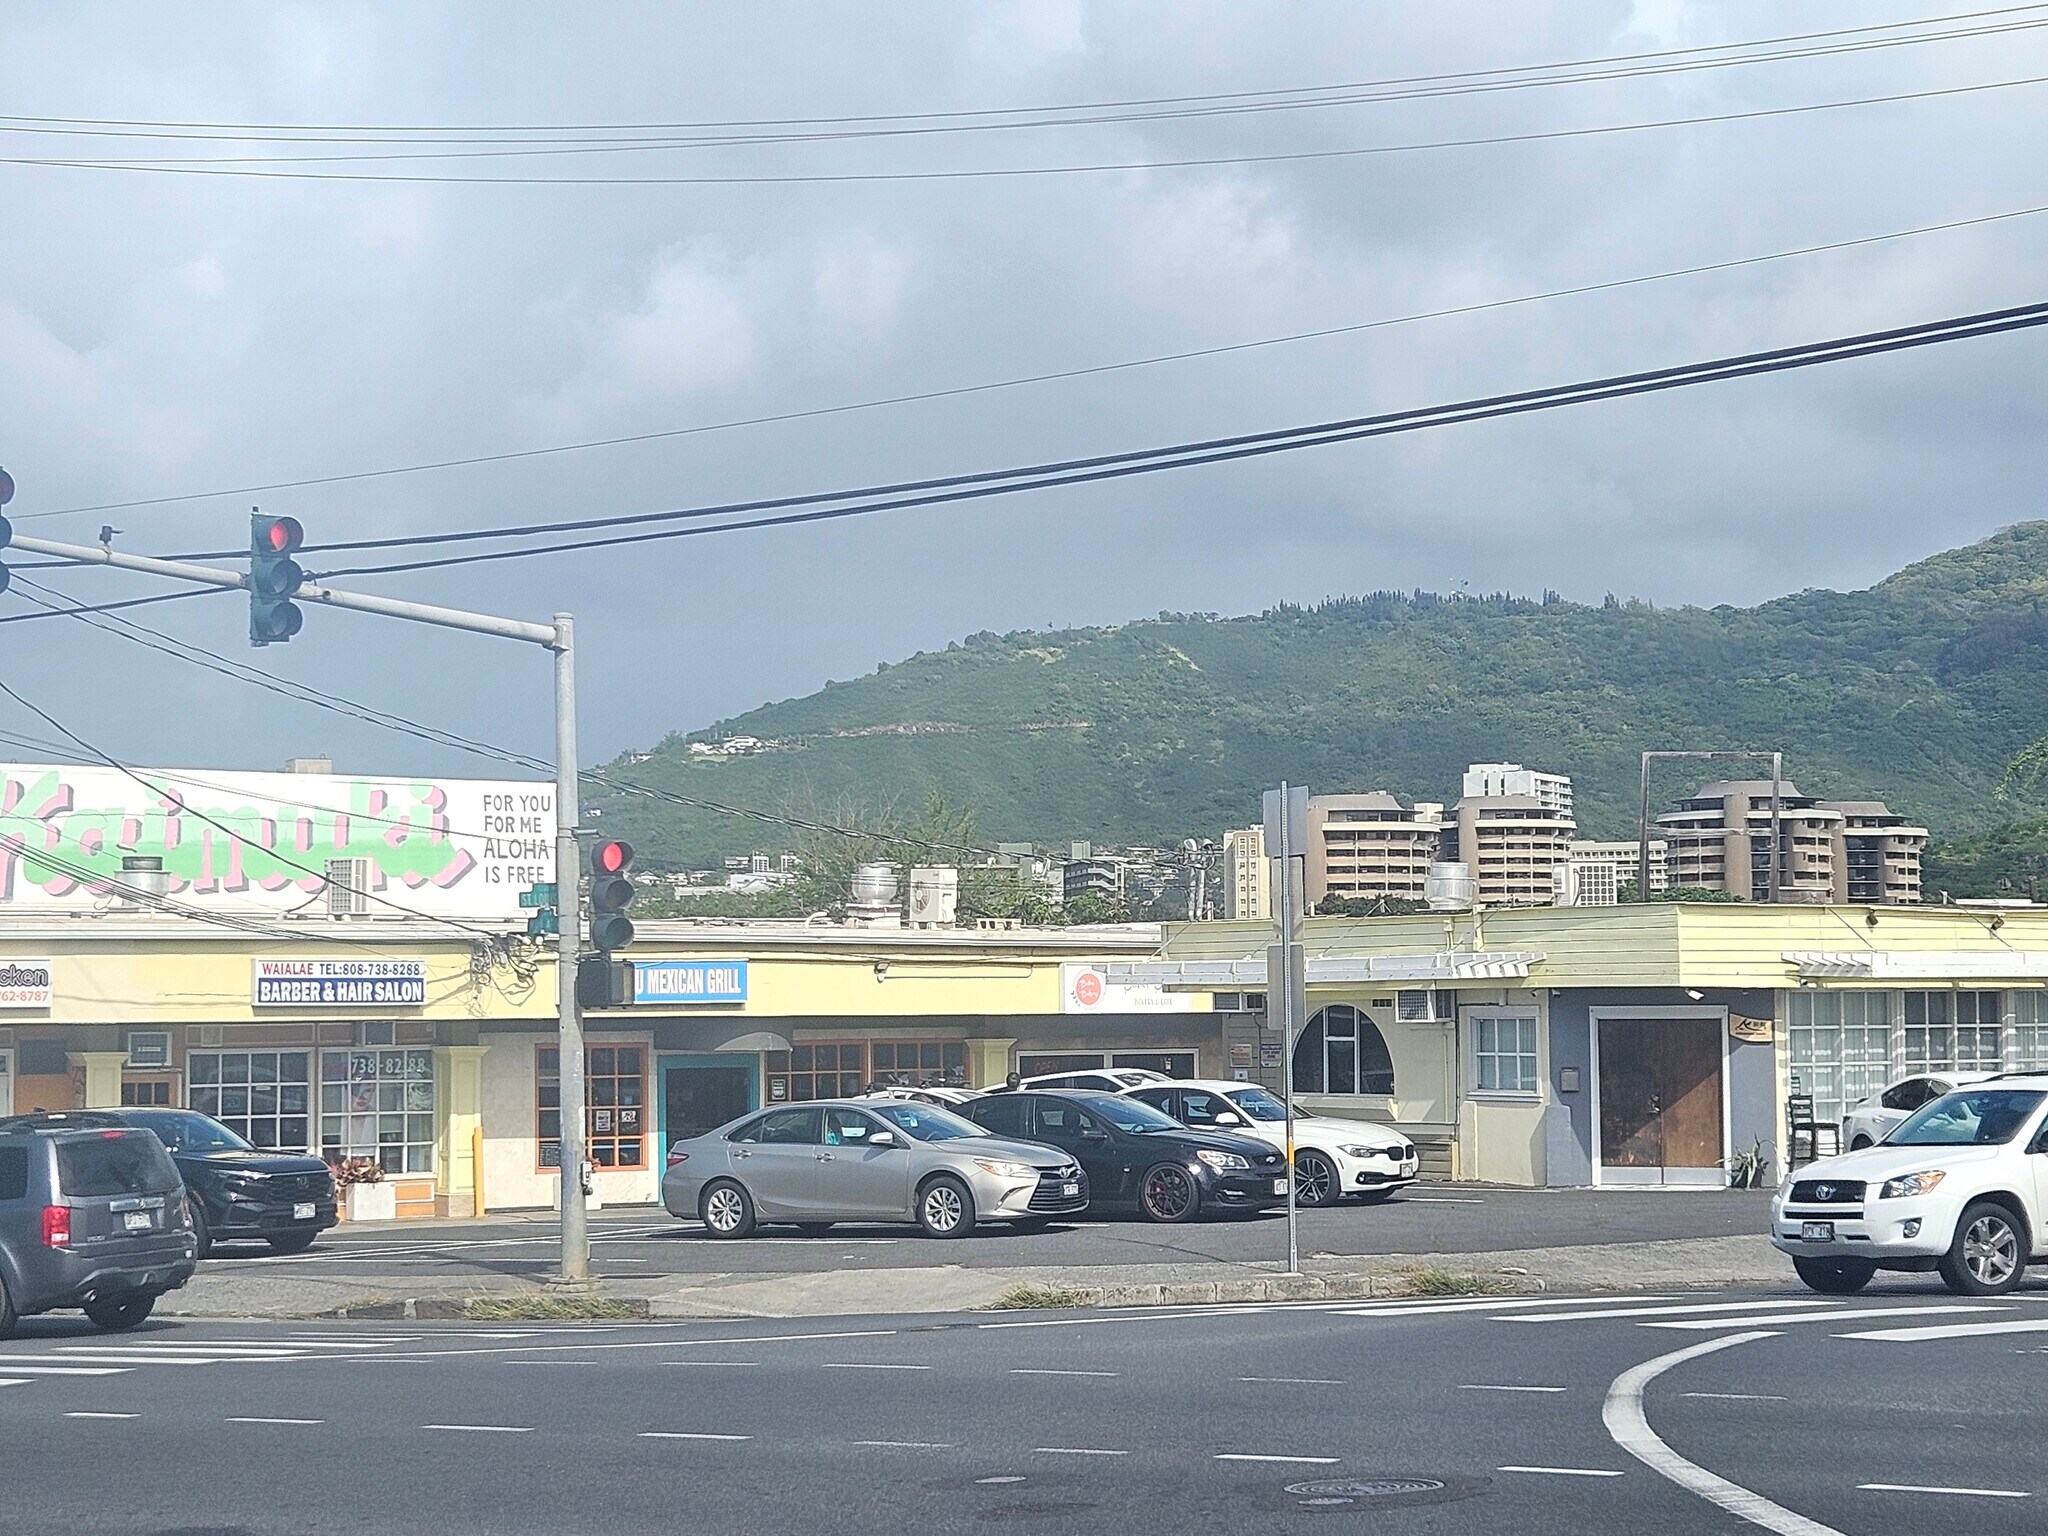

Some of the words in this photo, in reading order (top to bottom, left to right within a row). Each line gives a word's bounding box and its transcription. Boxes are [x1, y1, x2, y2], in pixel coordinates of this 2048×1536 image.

[483, 795, 514, 812] FOR
[519, 795, 551, 812] YOU
[484, 815, 515, 833] FOR
[520, 816, 542, 833] ME
[483, 838, 550, 860] ALOHA
[485, 866, 501, 883] IS
[507, 866, 545, 883] FREE
[262, 963, 314, 975] WAIALAE
[647, 968, 704, 994] MEXICAN
[707, 968, 741, 994] GRILL
[0, 990, 49, 1001] 62-8787
[260, 981, 321, 1002] BARBER
[322, 981, 335, 1002] &
[337, 981, 373, 1002] HAIR
[374, 981, 423, 1002] SALON
